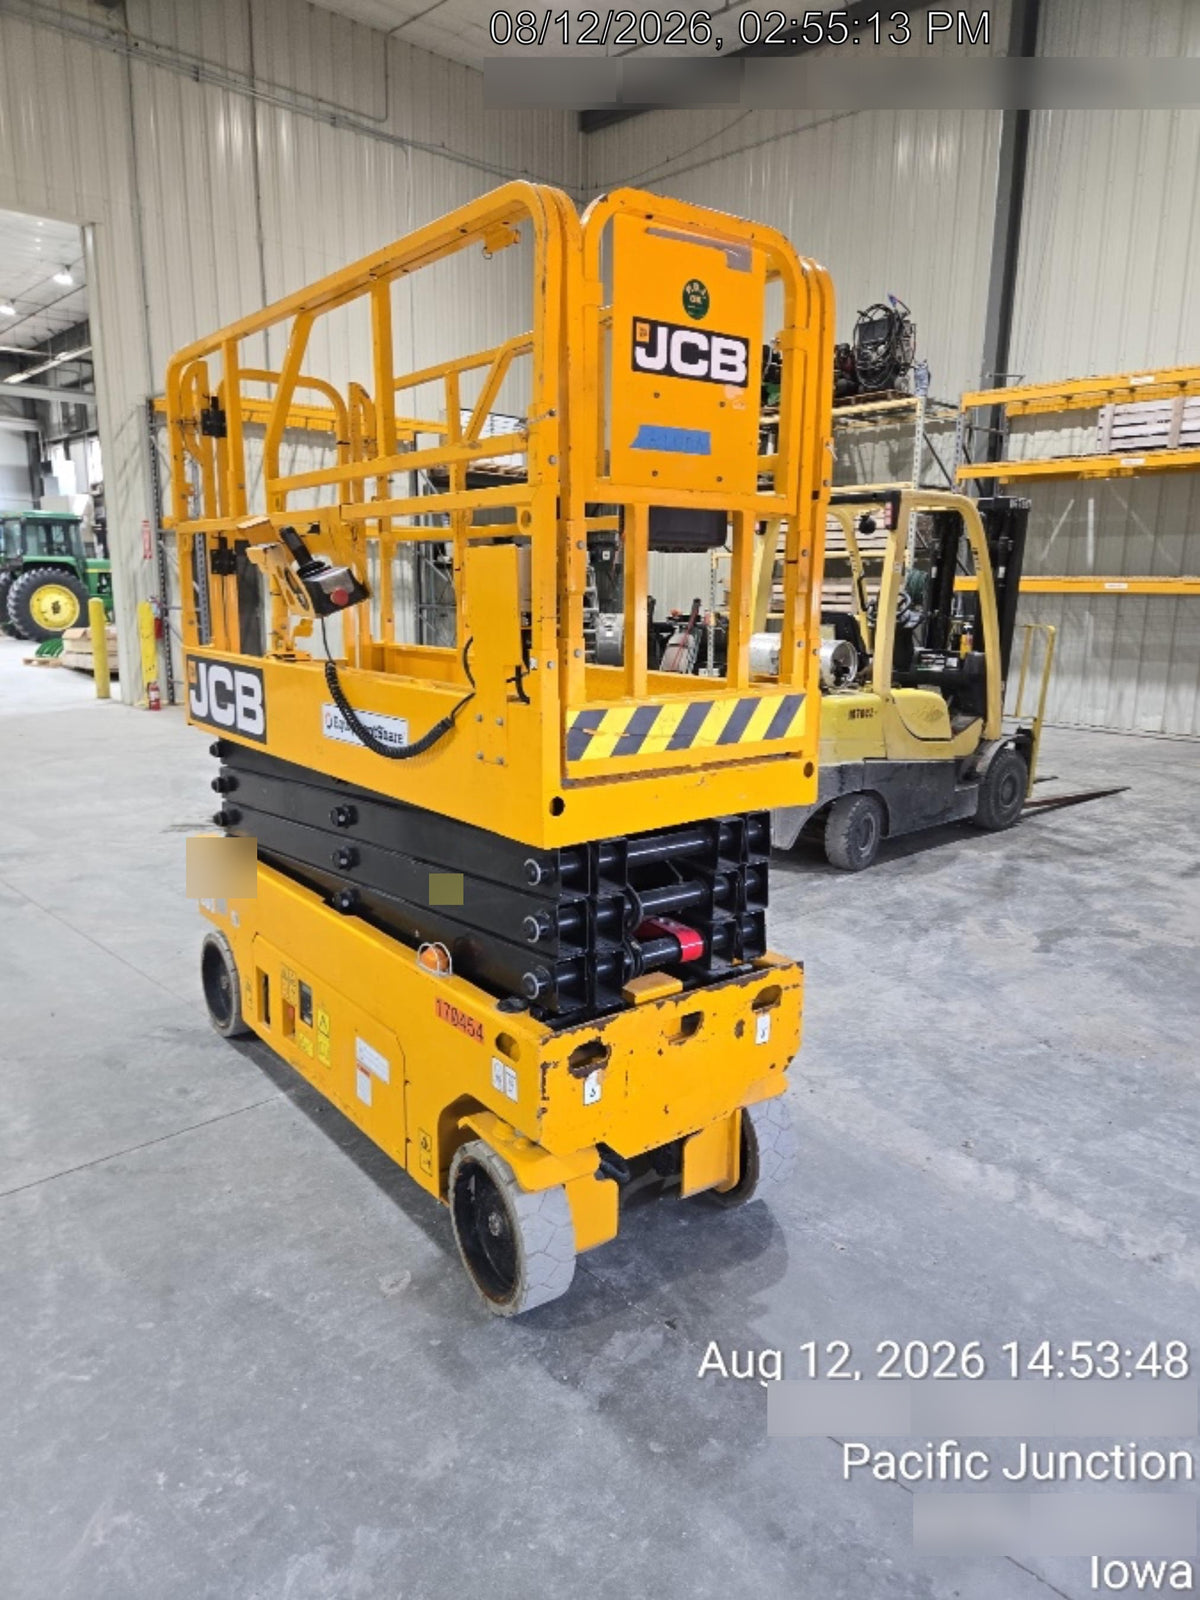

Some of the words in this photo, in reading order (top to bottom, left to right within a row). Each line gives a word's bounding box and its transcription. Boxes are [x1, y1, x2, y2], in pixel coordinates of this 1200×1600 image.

[634, 326, 747, 383] JCB
[189, 662, 265, 735] JCB
[435, 998, 484, 1042] 170454
